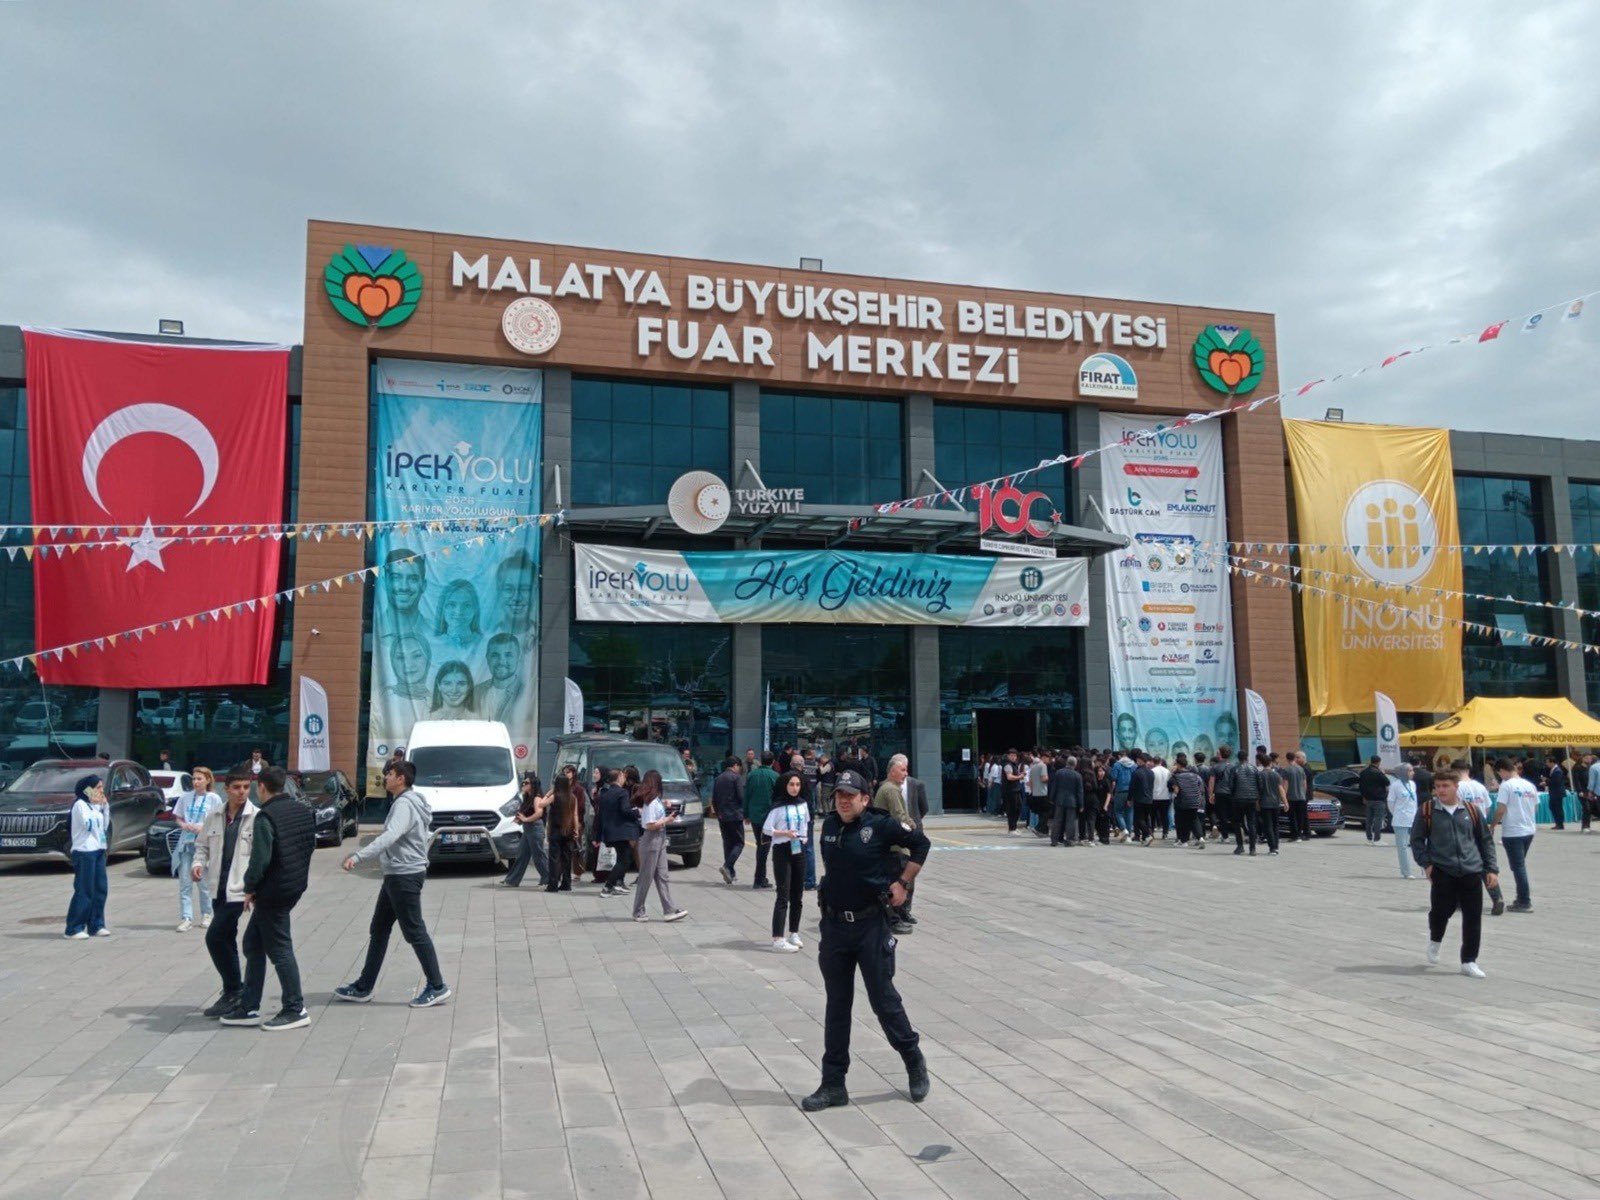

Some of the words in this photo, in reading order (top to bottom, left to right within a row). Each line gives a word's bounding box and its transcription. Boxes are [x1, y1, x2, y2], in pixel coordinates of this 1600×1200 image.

[451, 250, 671, 307] MALATYA
[687, 274, 943, 332] BÜYÜKŞEHİR
[958, 300, 1167, 349] BELEDİYESİ
[637, 317, 776, 366] FUAR
[806, 331, 1019, 384] MERKEZİ
[1081, 371, 1120, 384] FIRAT
[386, 443, 533, 484] İPEKYOLU
[386, 483, 465, 494] KARİYER
[480, 486, 534, 496] FUARI
[589, 563, 689, 592] İPEKYOLU
[735, 559, 812, 601] Hoş
[819, 560, 952, 614] Geldiniz
[1342, 599, 1443, 630] İNÖNÜ
[1341, 632, 1444, 650] ÜNİVERSİTESİ
